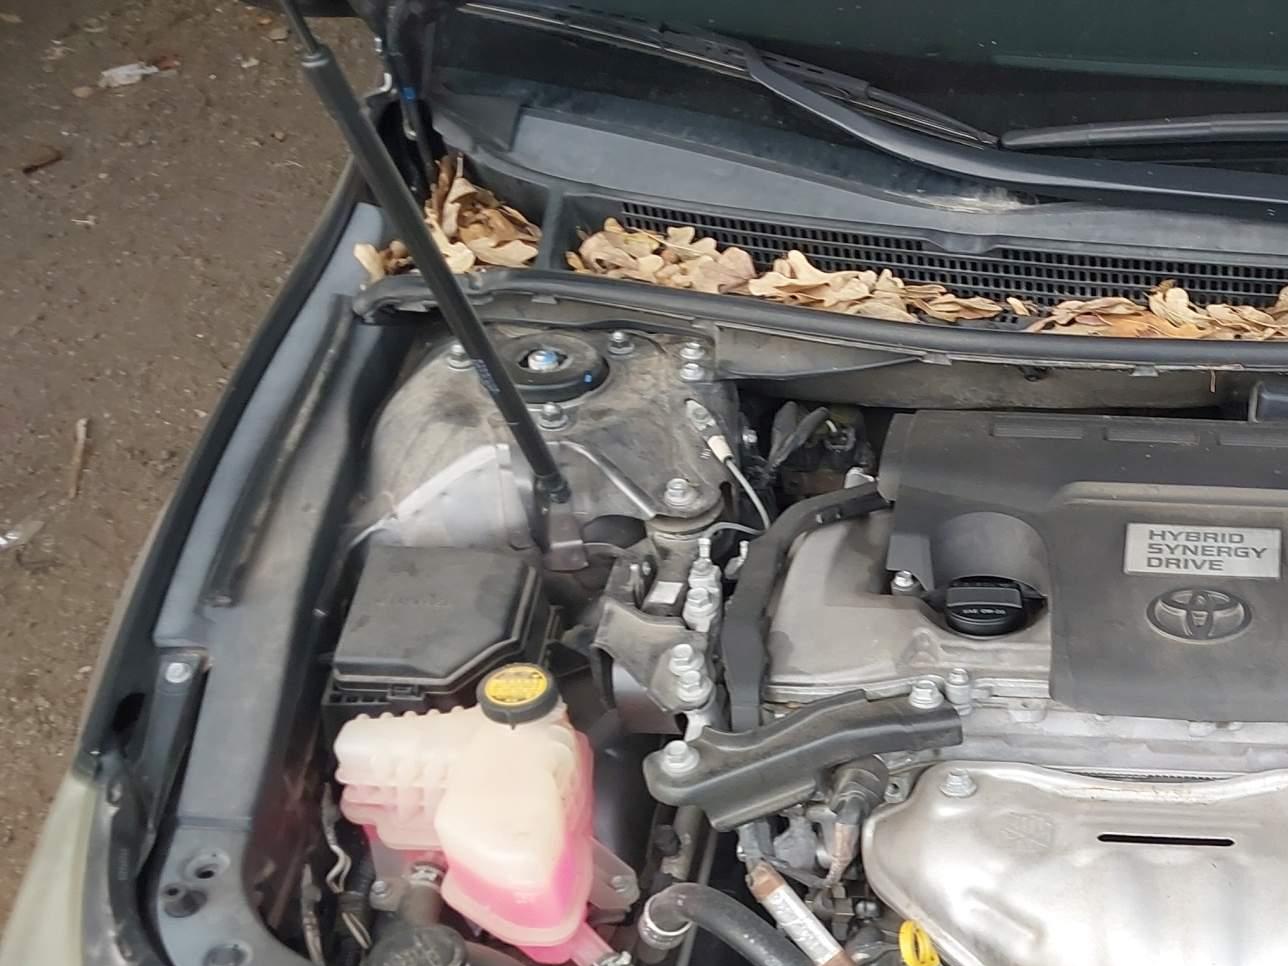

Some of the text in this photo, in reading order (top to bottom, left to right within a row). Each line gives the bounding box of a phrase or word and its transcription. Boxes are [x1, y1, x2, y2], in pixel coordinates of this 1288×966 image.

[1148, 529, 1245, 544] HYBRID
[1147, 543, 1268, 559] SYNERGY
[1146, 557, 1225, 571] DRIVE
